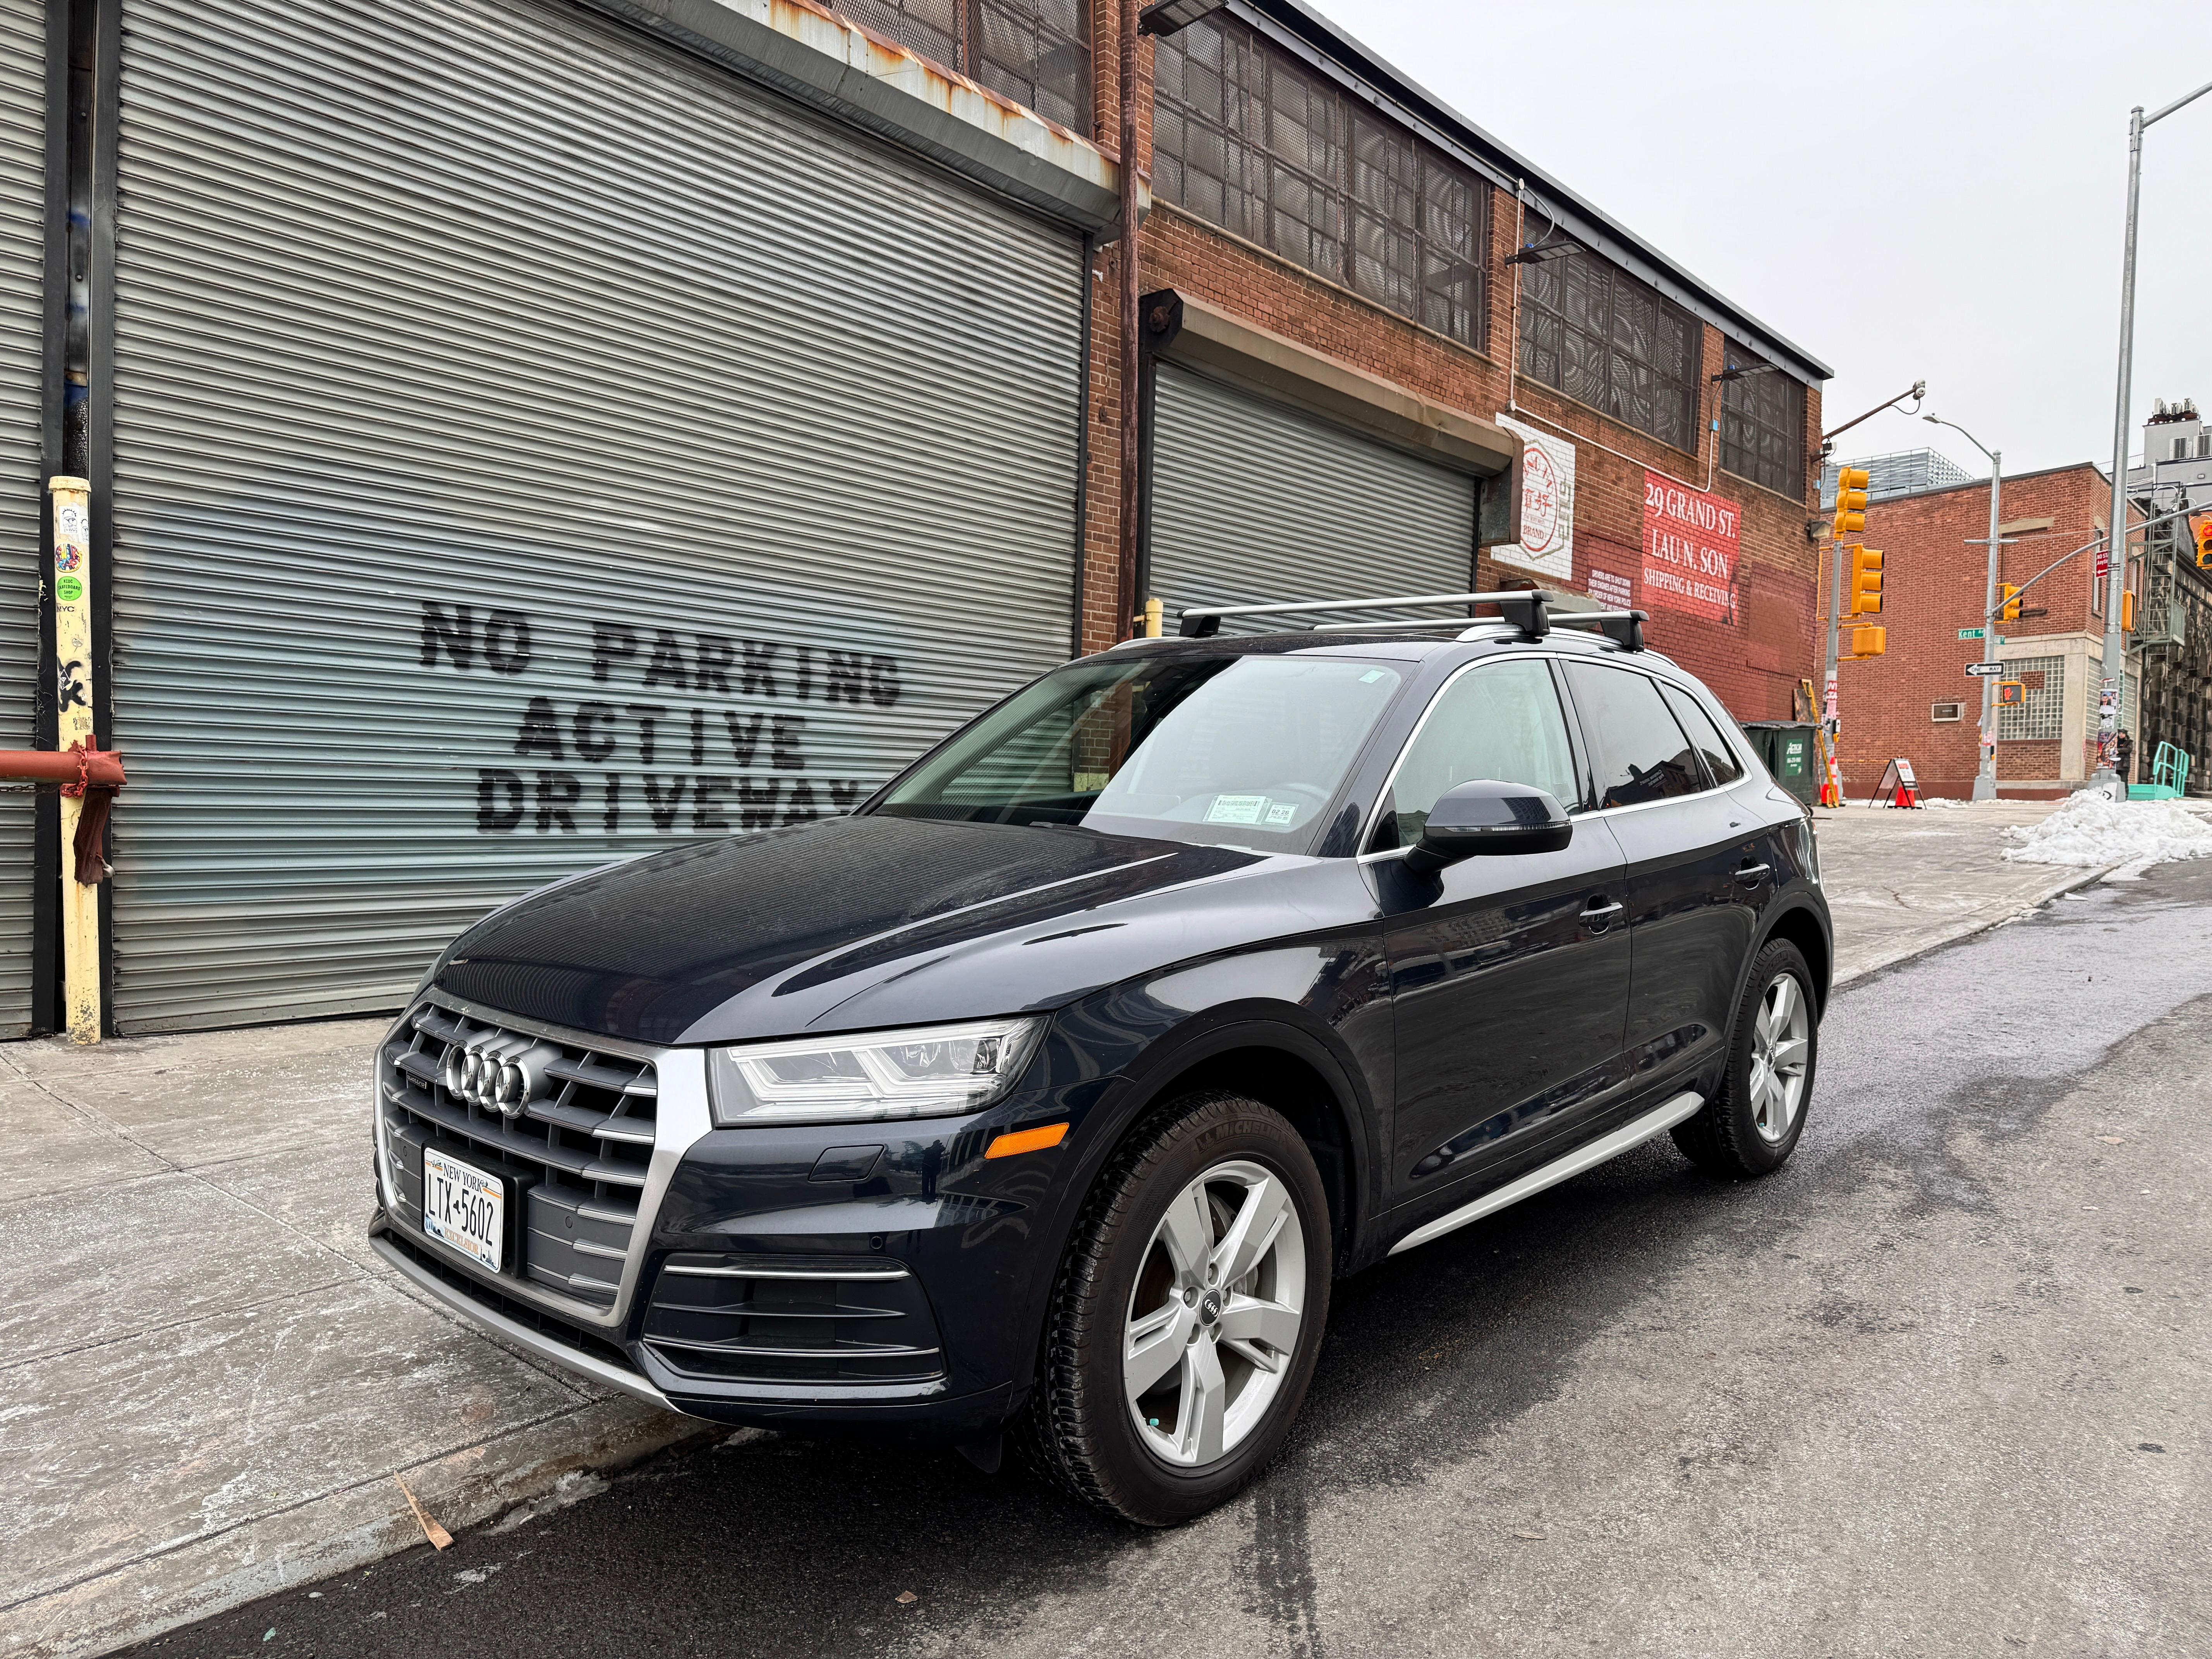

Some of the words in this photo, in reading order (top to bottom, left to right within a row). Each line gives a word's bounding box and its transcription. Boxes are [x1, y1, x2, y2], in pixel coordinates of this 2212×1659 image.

[1523, 524, 1544, 539] BRAND
[1646, 483, 1664, 517] 29
[1666, 489, 1716, 530] GRAND
[1718, 509, 1736, 539] ST.
[1652, 529, 1680, 563] LAU
[1683, 540, 1697, 570] N.
[1700, 547, 1728, 579] SON
[1644, 567, 1685, 594] SHIPPING
[1686, 580, 1692, 597] &
[1694, 582, 1736, 609] RECEIVING
[420, 600, 531, 676] NO
[591, 620, 902, 707] PARKING
[1958, 630, 1975, 639] Kent
[514, 696, 805, 771] ACTIVE
[476, 768, 859, 835] DRIVEWAY
[407, 1075, 425, 1087] quattro
[1216, 1120, 1281, 1143] MICHELIN
[443, 1163, 460, 1182] NEW
[463, 1173, 483, 1194] YORK
[429, 1173, 451, 1224] LTX
[462, 1188, 494, 1246] 5602
[445, 1227, 479, 1255] EXCELSIOR
